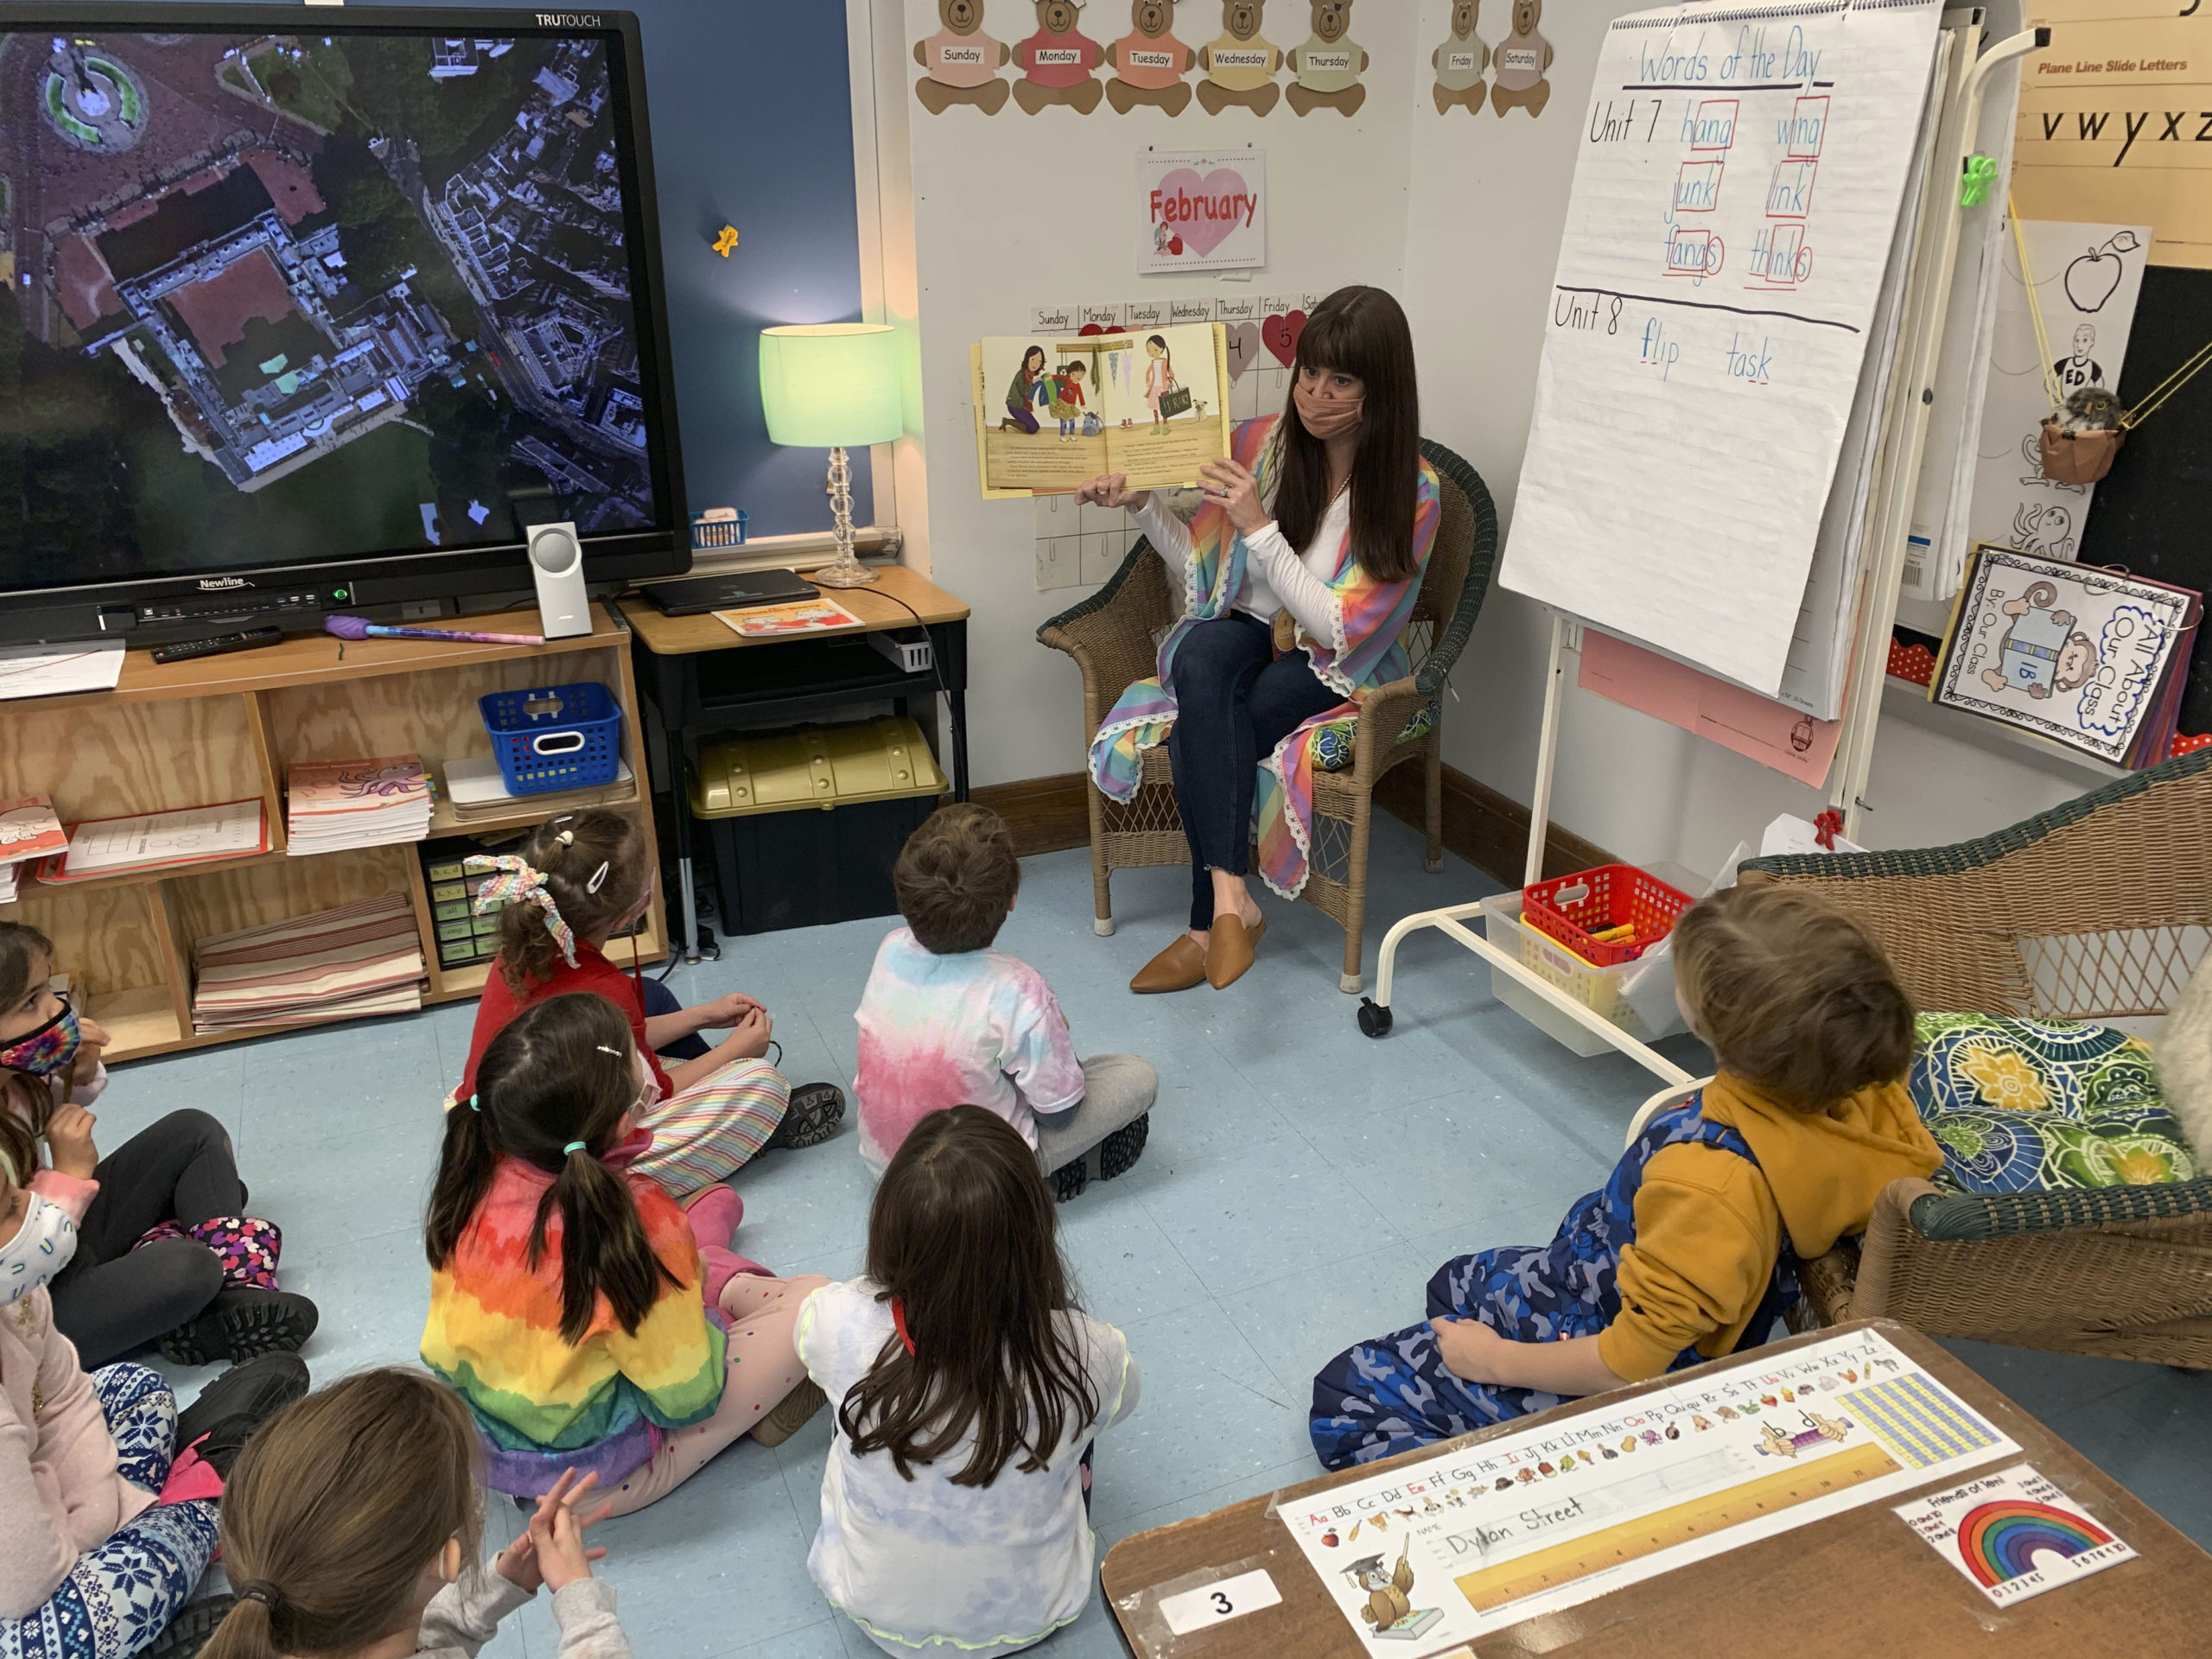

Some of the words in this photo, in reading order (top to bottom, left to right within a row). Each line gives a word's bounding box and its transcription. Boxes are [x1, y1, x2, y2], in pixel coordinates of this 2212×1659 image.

[535, 13, 602, 28] TRUTOUCH
[944, 49, 982, 63] Sunday
[1038, 50, 1077, 64] Monday
[1130, 53, 1171, 67] Tuesday
[1214, 53, 1268, 67] Wednesday
[1308, 55, 1351, 69] Thursday
[1451, 54, 1472, 67] Friday
[1505, 53, 1537, 67] Saturday
[1641, 32, 1709, 84] Words
[1720, 25, 1751, 79] of
[1750, 28, 1777, 79] the
[1783, 24, 1822, 99] Day
[2037, 62, 2073, 74] Plane
[2075, 60, 2103, 73] Line
[2106, 60, 2137, 73] Slide
[2139, 59, 2188, 72] Letters
[1589, 99, 1635, 143] Unit
[1645, 99, 1662, 143] 7
[1681, 99, 1732, 166] hang
[1777, 117, 1821, 167] wing
[2043, 112, 2064, 141] v
[2078, 112, 2110, 141] w
[2113, 111, 2149, 168] y
[2158, 111, 2187, 141] x
[1664, 162, 1716, 225] junk
[1765, 163, 1808, 213] link
[1149, 186, 1258, 229] February
[1663, 224, 1719, 287] fangs
[1750, 227, 1808, 277] thinks
[1039, 309, 1070, 330] Sunday
[1084, 306, 1116, 327] Monday
[1128, 304, 1160, 325] Tuesday
[1172, 302, 1210, 322] Wednesday
[1218, 299, 1253, 320] Thursday
[1263, 298, 1291, 315] Friday
[1555, 292, 1599, 332] Unit
[1607, 296, 1623, 335] 8
[1229, 337, 1243, 359] 4
[1280, 327, 1293, 348] 5
[1641, 317, 1680, 383] flip
[1726, 332, 1773, 380] task
[2066, 368, 2086, 386] ED
[200, 576, 245, 589] Newline
[1985, 588, 2005, 608] By:
[1977, 613, 1997, 640] Our
[2108, 616, 2135, 659] Our
[2134, 624, 2159, 655] All
[1967, 642, 1988, 675] Class
[2085, 665, 2116, 716] Class
[2109, 658, 2145, 723] About
[1309, 1513, 1329, 1527] Aa
[1332, 1505, 1351, 1519] Bb
[1357, 1497, 1376, 1510] Cc
[1381, 1488, 1402, 1503] Dd
[1406, 1483, 1426, 1495] Ee
[1452, 1467, 1477, 1482] Gg
[1477, 1459, 1498, 1473] Hh
[1524, 1446, 1542, 1461] Jj
[1540, 1440, 1560, 1453] Kk
[1576, 1429, 1603, 1442] Mm
[1601, 1423, 1623, 1435] Nn
[1624, 1415, 1645, 1427] Oo
[1645, 1409, 1664, 1423] Pp
[1700, 1393, 1718, 1404] Rr
[1744, 1380, 1758, 1392] Tt
[1759, 1375, 1781, 1386] Uu
[1777, 1369, 1796, 1381] Vv
[1796, 1365, 1820, 1376] Ww
[1819, 1357, 1840, 1369] Xx
[1840, 1351, 1859, 1365] Yy
[1859, 1345, 1878, 1356] Zz
[1928, 1489, 1968, 1507] Friends
[1968, 1482, 1984, 1494] of
[1446, 1526, 1514, 1556] Dylan
[1520, 1497, 1585, 1531] Street
[1210, 1592, 1234, 1614] 3
